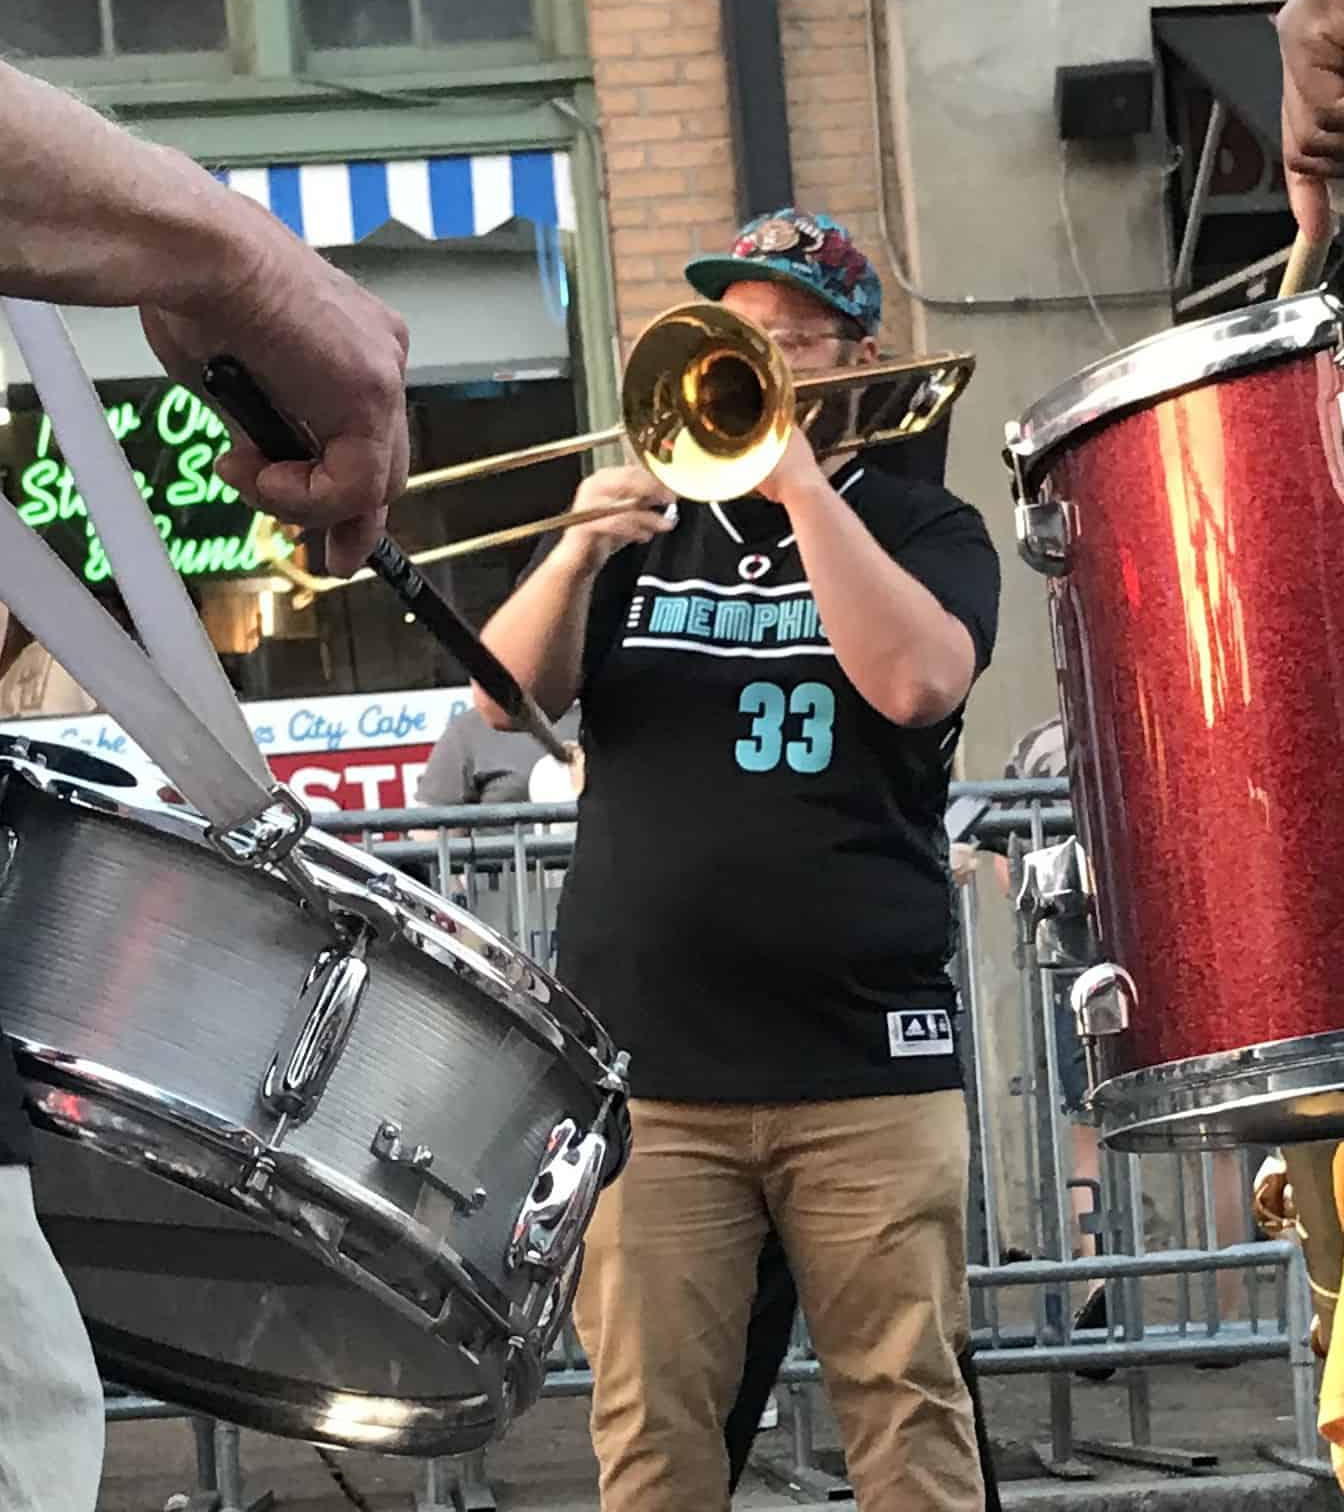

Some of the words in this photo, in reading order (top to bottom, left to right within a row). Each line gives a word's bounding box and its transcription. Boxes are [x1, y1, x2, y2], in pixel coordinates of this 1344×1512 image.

[648, 595, 827, 643] MEMPHI
[288, 709, 348, 750] City
[735, 681, 836, 774] 33
